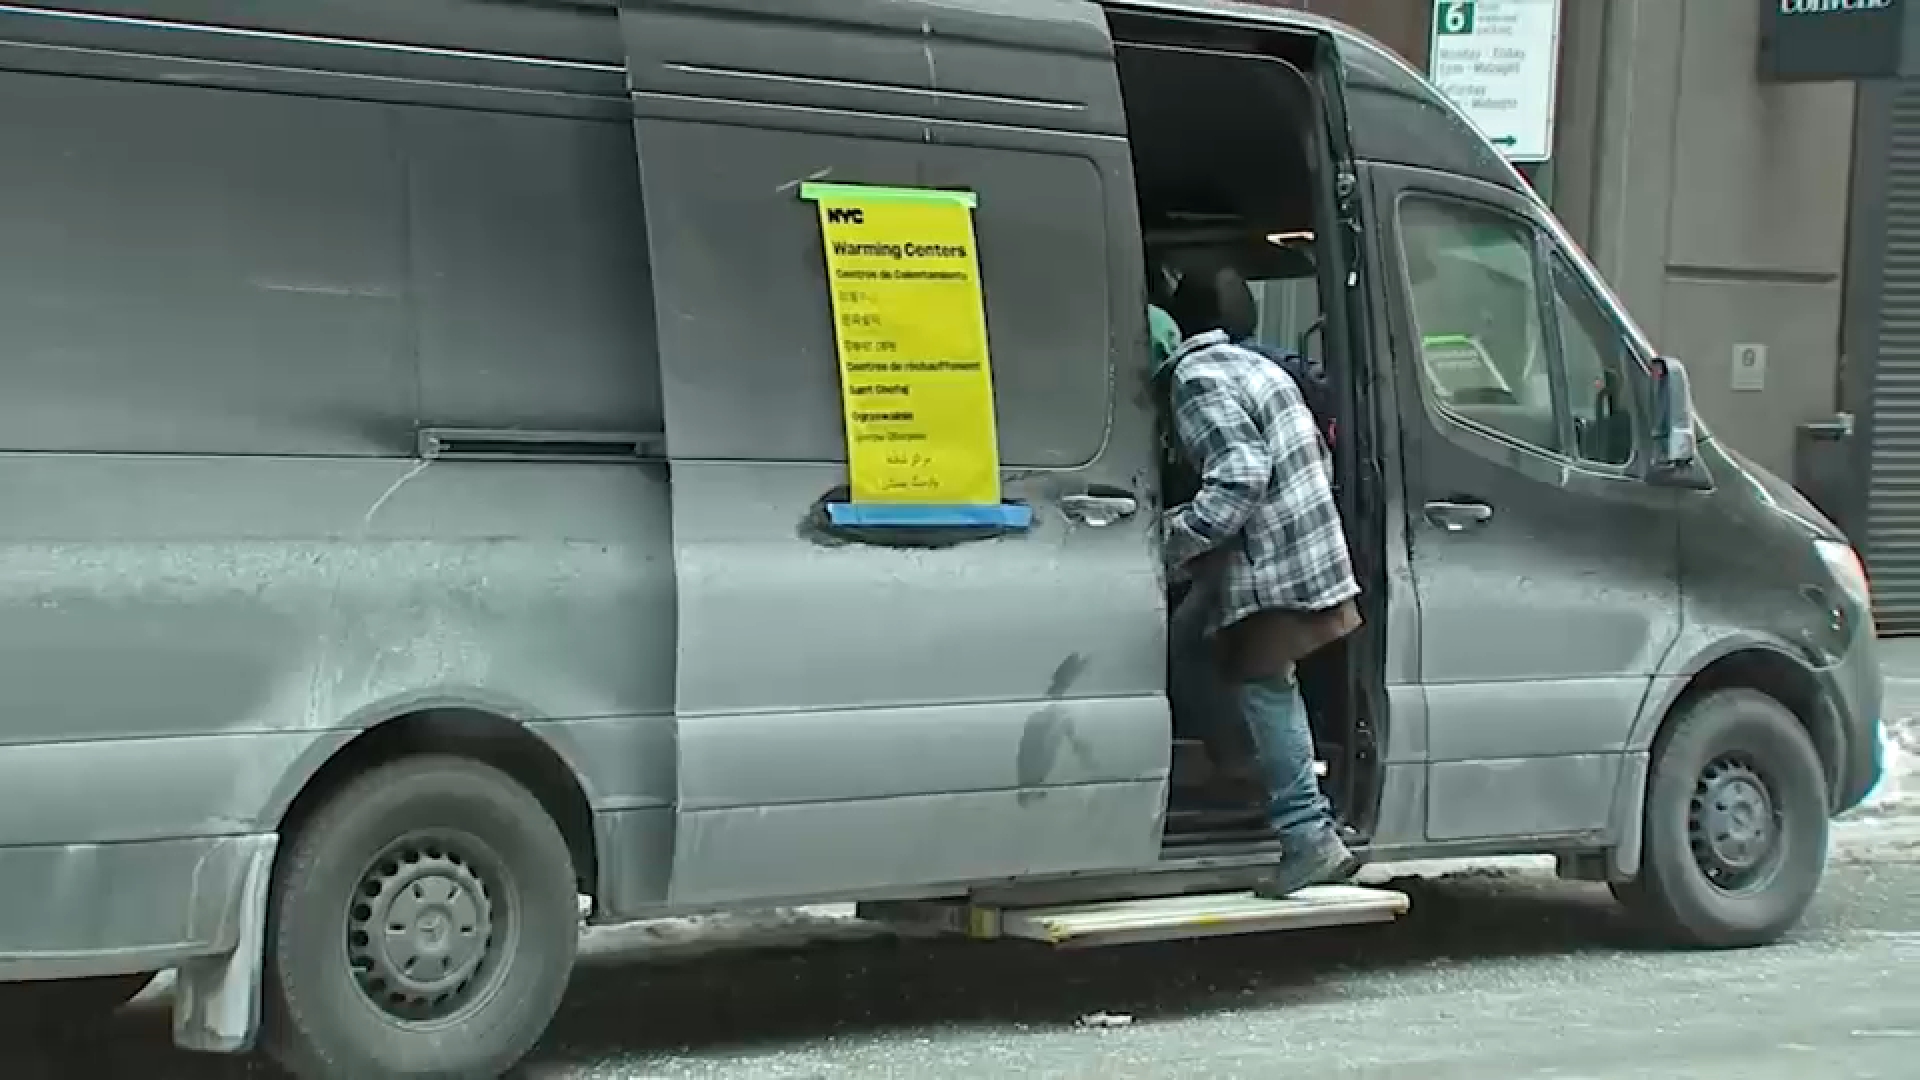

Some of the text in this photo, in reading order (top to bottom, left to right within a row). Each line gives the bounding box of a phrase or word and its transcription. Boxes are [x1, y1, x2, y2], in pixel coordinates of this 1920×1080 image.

[1445, 1, 1465, 31] 6
[827, 207, 864, 225] NYC
[832, 241, 967, 260] Warming Centers
